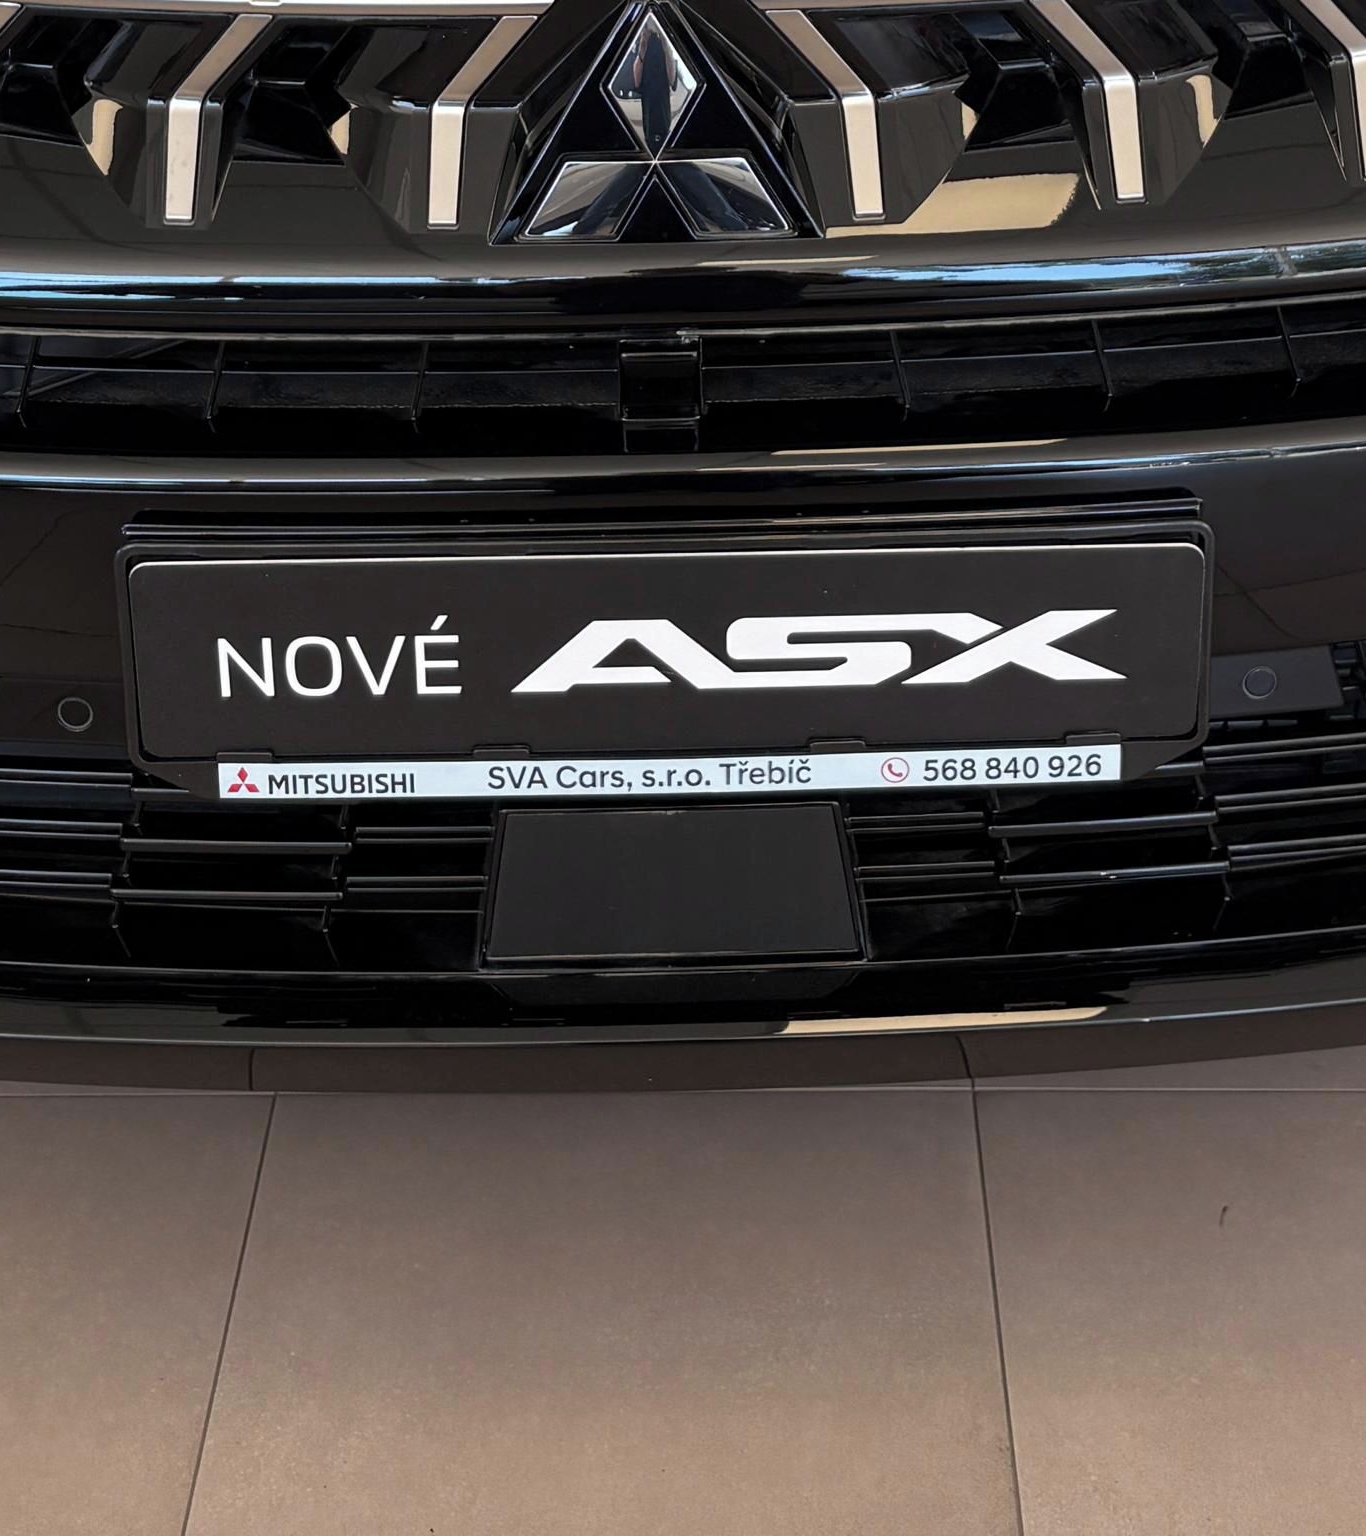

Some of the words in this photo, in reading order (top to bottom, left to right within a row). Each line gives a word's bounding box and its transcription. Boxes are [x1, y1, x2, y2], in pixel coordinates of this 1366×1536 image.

[217, 614, 463, 698] NOVÉ
[509, 608, 1128, 690] ASX
[487, 765, 548, 790] SVA
[555, 765, 633, 792] Cars,
[641, 767, 711, 788] s.r.o.
[718, 758, 812, 786] Třebíč
[923, 758, 977, 782] 568
[985, 756, 1039, 780] 840
[1048, 754, 1102, 778] 926
[267, 773, 416, 795] MITSUBISHI
